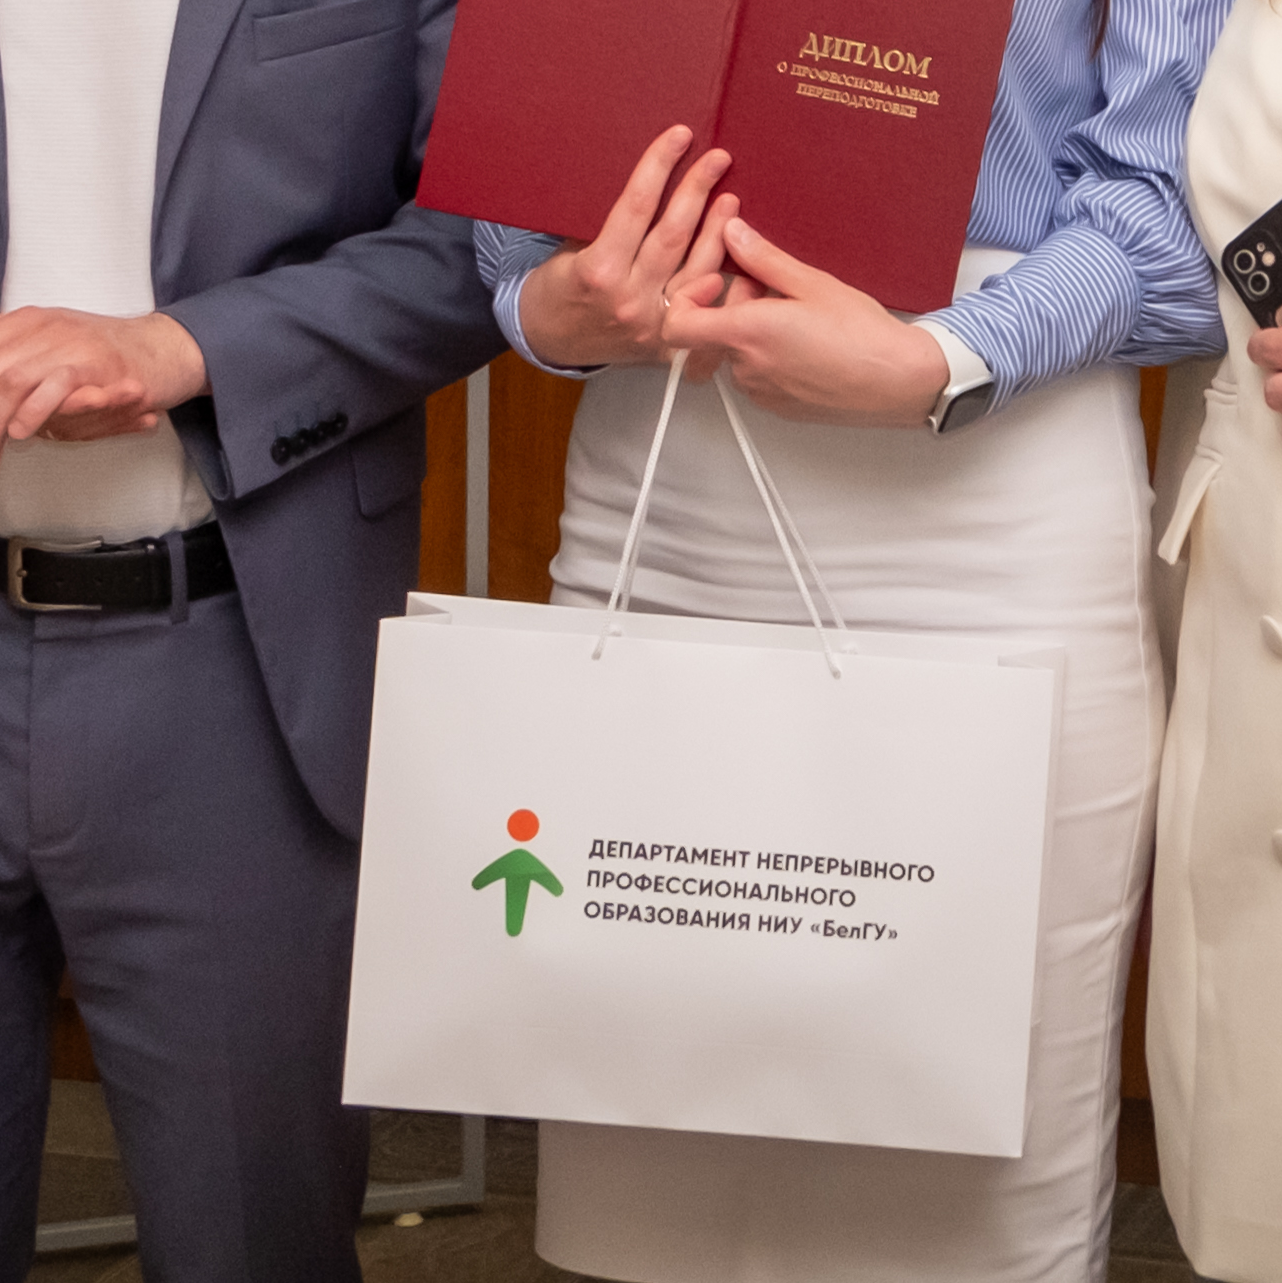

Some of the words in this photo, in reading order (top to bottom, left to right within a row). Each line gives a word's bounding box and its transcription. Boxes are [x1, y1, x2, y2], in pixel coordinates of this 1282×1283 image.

[799, 31, 933, 79] ДИПЛОМ
[790, 63, 941, 106] ПРОФЕССИОНАЛЬНОЙ
[796, 82, 918, 118] ПЕРЕПОДГОТОВКЕ
[588, 839, 751, 869] ДЕПАРТАМЕНТ
[756, 852, 935, 884] НЕПРЕРЫВНОГО
[586, 870, 857, 908] ПРОФЕССИОНАЛЬНОГО
[583, 900, 751, 932] ОБРАЗОВАНИЯ
[757, 914, 804, 935] НИУ
[809, 918, 899, 942] «БелГУ»
